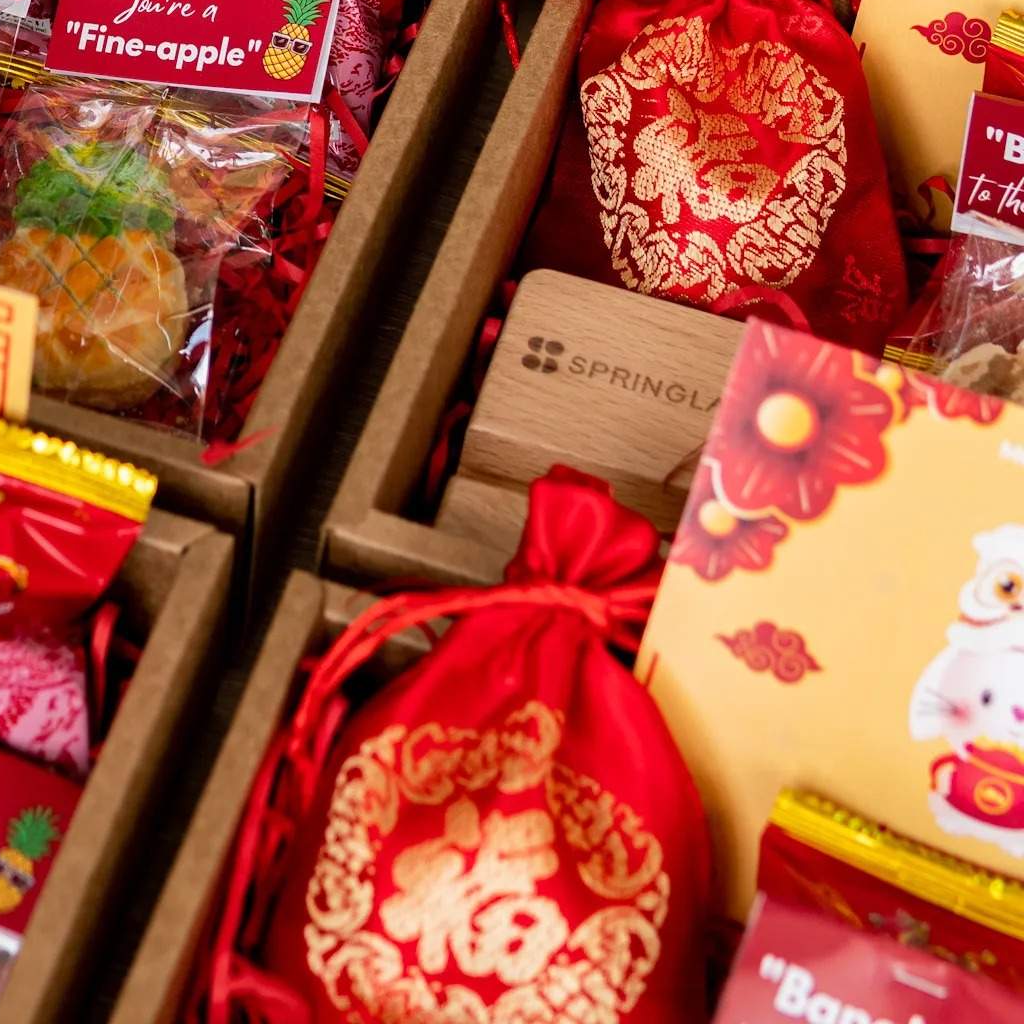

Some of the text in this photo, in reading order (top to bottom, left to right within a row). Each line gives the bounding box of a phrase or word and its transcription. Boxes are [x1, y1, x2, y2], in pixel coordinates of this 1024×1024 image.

[201, 3, 218, 22] a
[66, 20, 262, 71] "Fine-apple"
[968, 174, 997, 206] to
[568, 356, 722, 413] SPRINGLA
